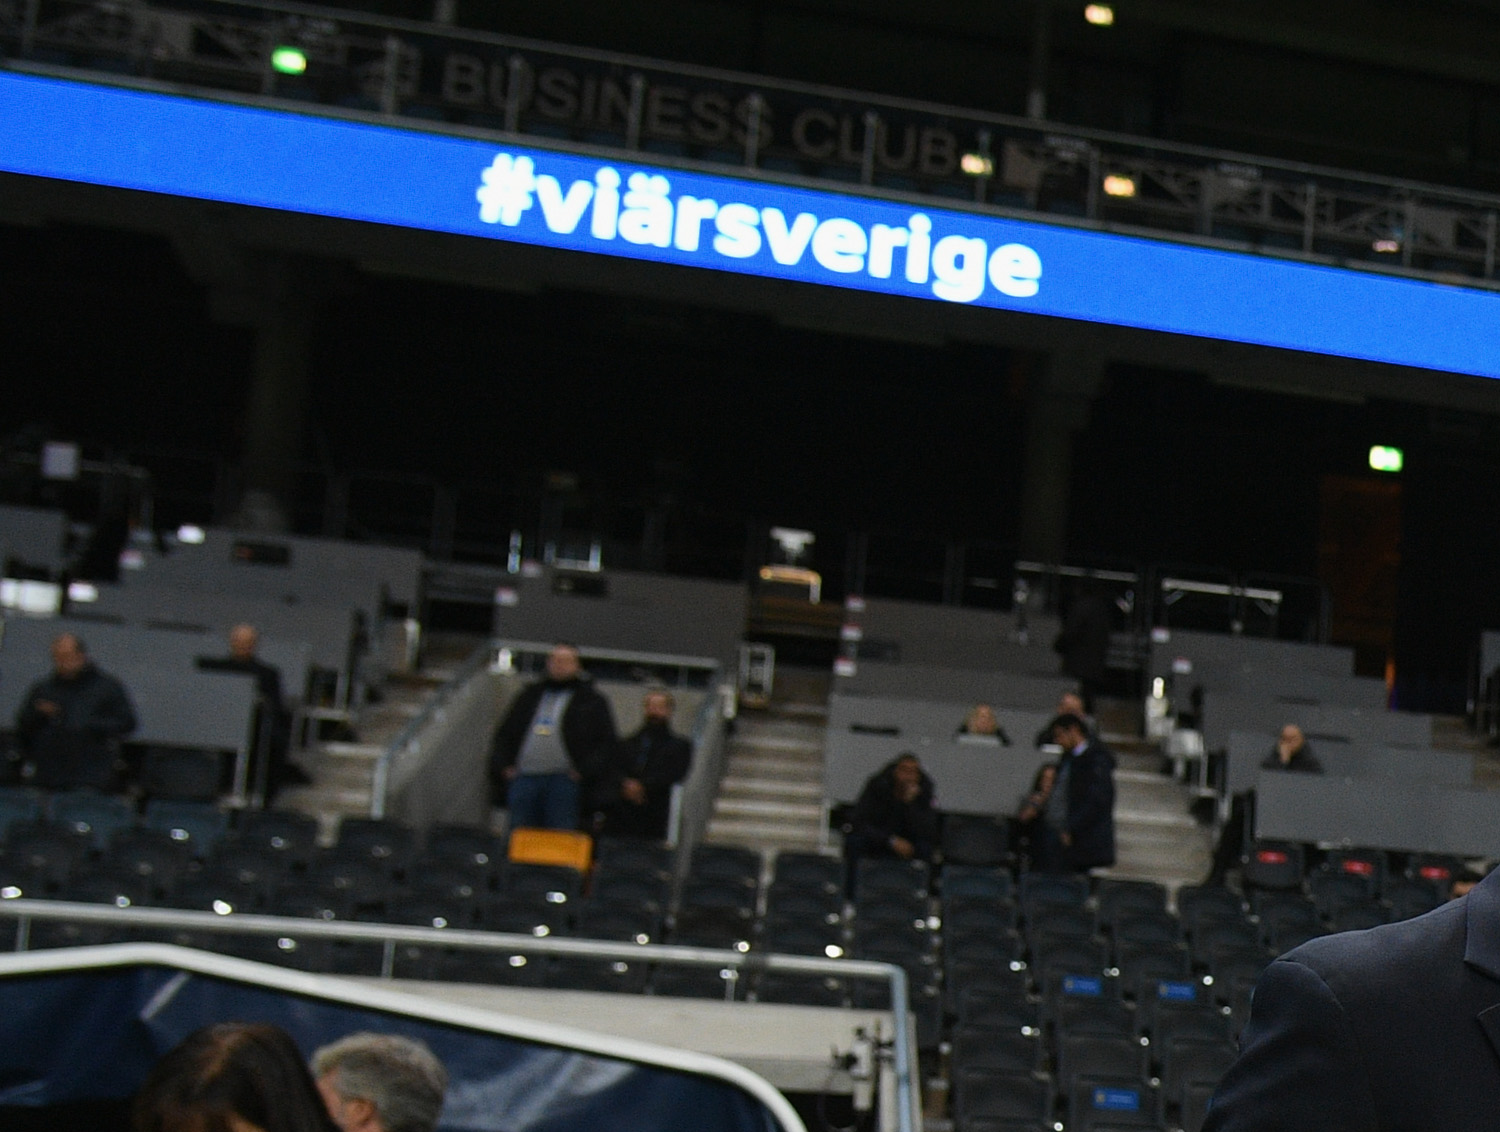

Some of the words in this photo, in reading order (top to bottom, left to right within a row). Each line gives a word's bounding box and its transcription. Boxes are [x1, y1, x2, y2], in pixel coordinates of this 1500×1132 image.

[444, 54, 773, 148] BUSINESS
[791, 106, 959, 176] CLUB
[477, 152, 1043, 303] #viärsverige
